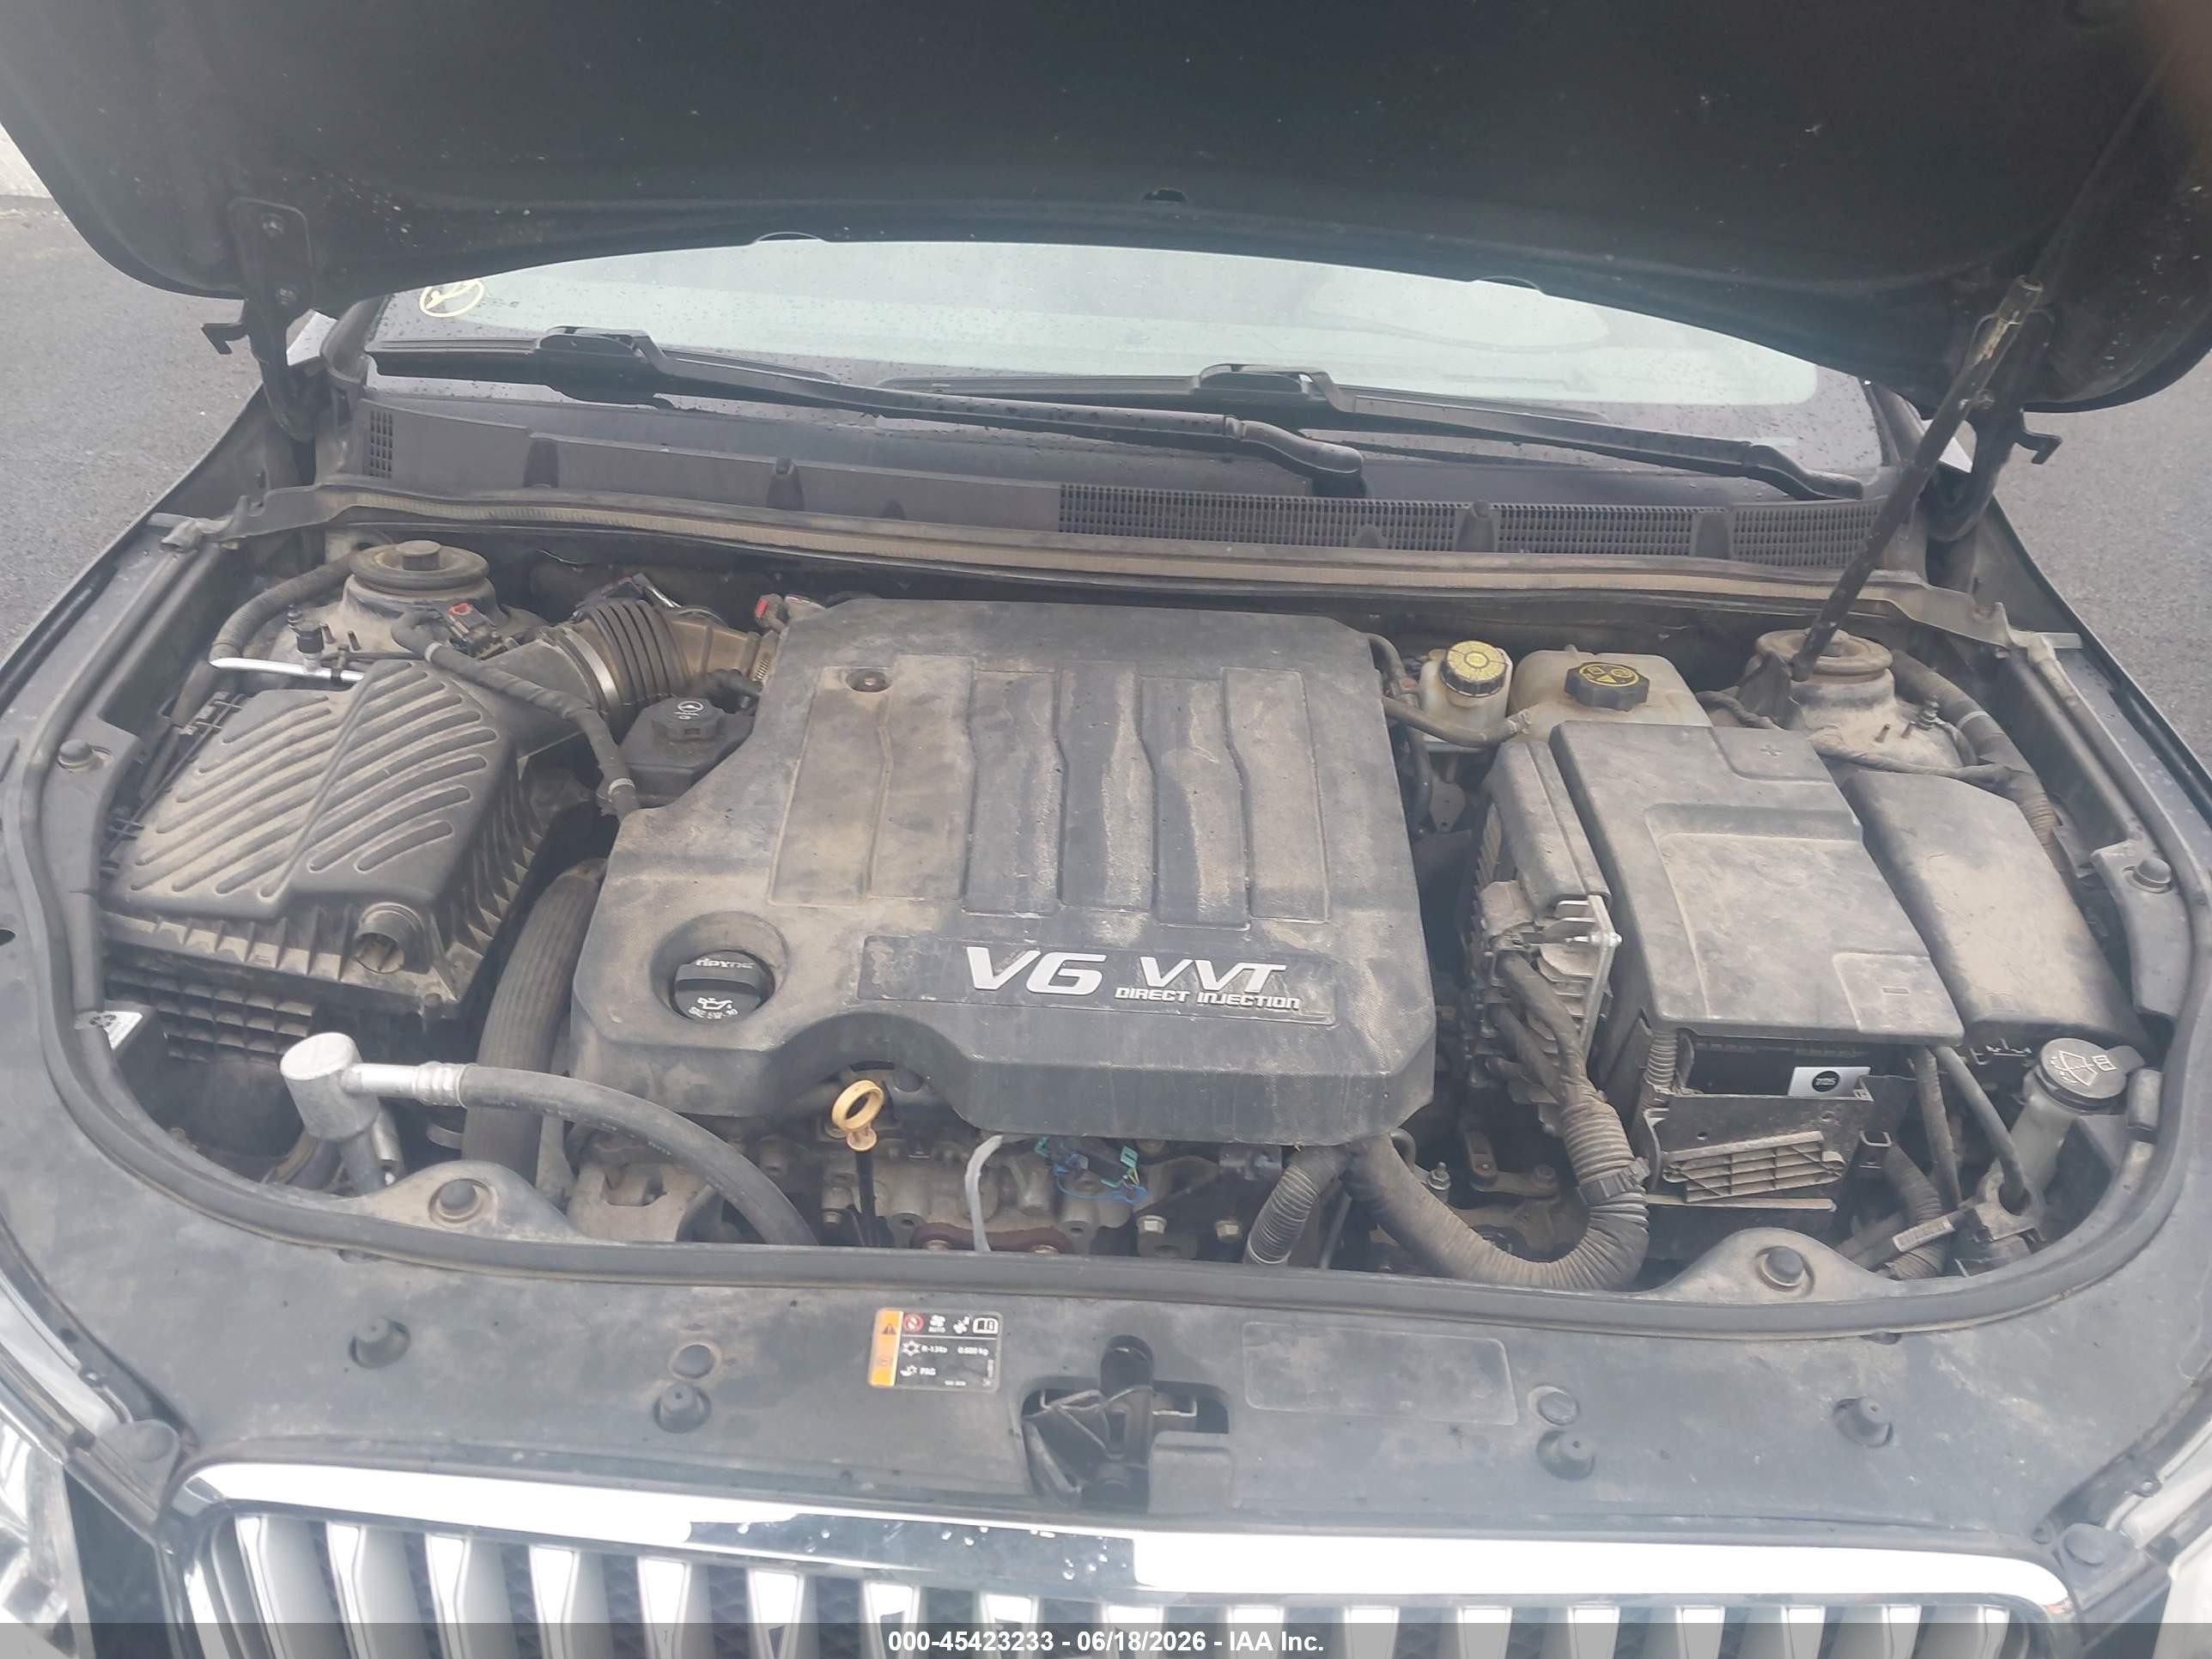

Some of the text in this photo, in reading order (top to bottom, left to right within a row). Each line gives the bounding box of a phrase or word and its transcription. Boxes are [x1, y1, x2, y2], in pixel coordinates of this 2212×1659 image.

[967, 946, 1287, 996] V6 VVT
[1115, 987, 1300, 1010] DIRECT INJECTION
